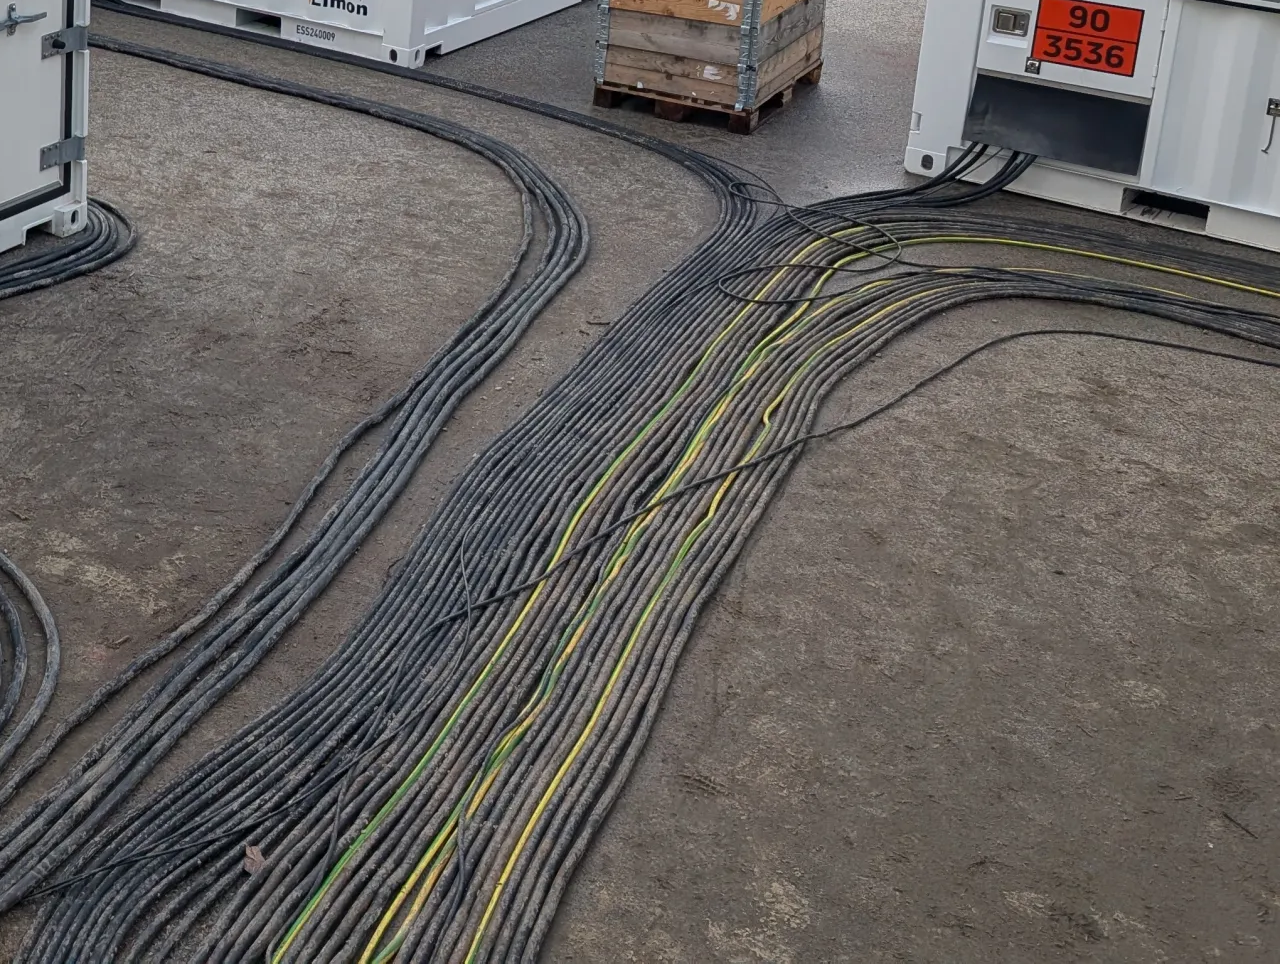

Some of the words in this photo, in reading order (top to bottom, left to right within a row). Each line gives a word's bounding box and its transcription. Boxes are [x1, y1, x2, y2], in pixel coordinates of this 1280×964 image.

[296, 24, 336, 42] ESS240009
[1068, 5, 1110, 33] 90
[1042, 34, 1125, 69] 3536
